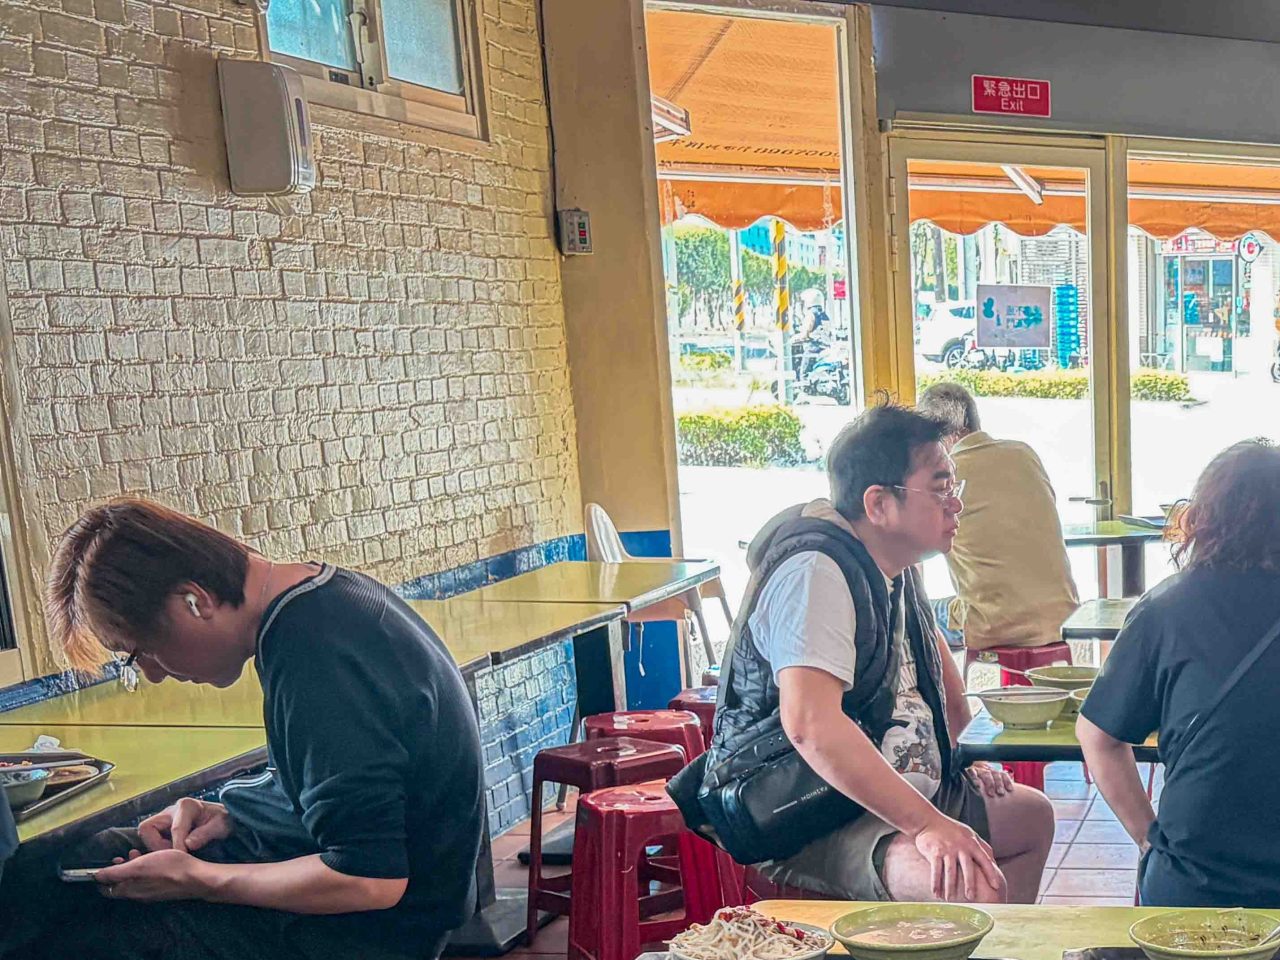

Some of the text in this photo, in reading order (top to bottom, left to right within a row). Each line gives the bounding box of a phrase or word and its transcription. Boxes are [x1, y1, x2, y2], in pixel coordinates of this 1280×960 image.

[983, 80, 1040, 100] 緊急出口
[1001, 98, 1024, 111] Exit
